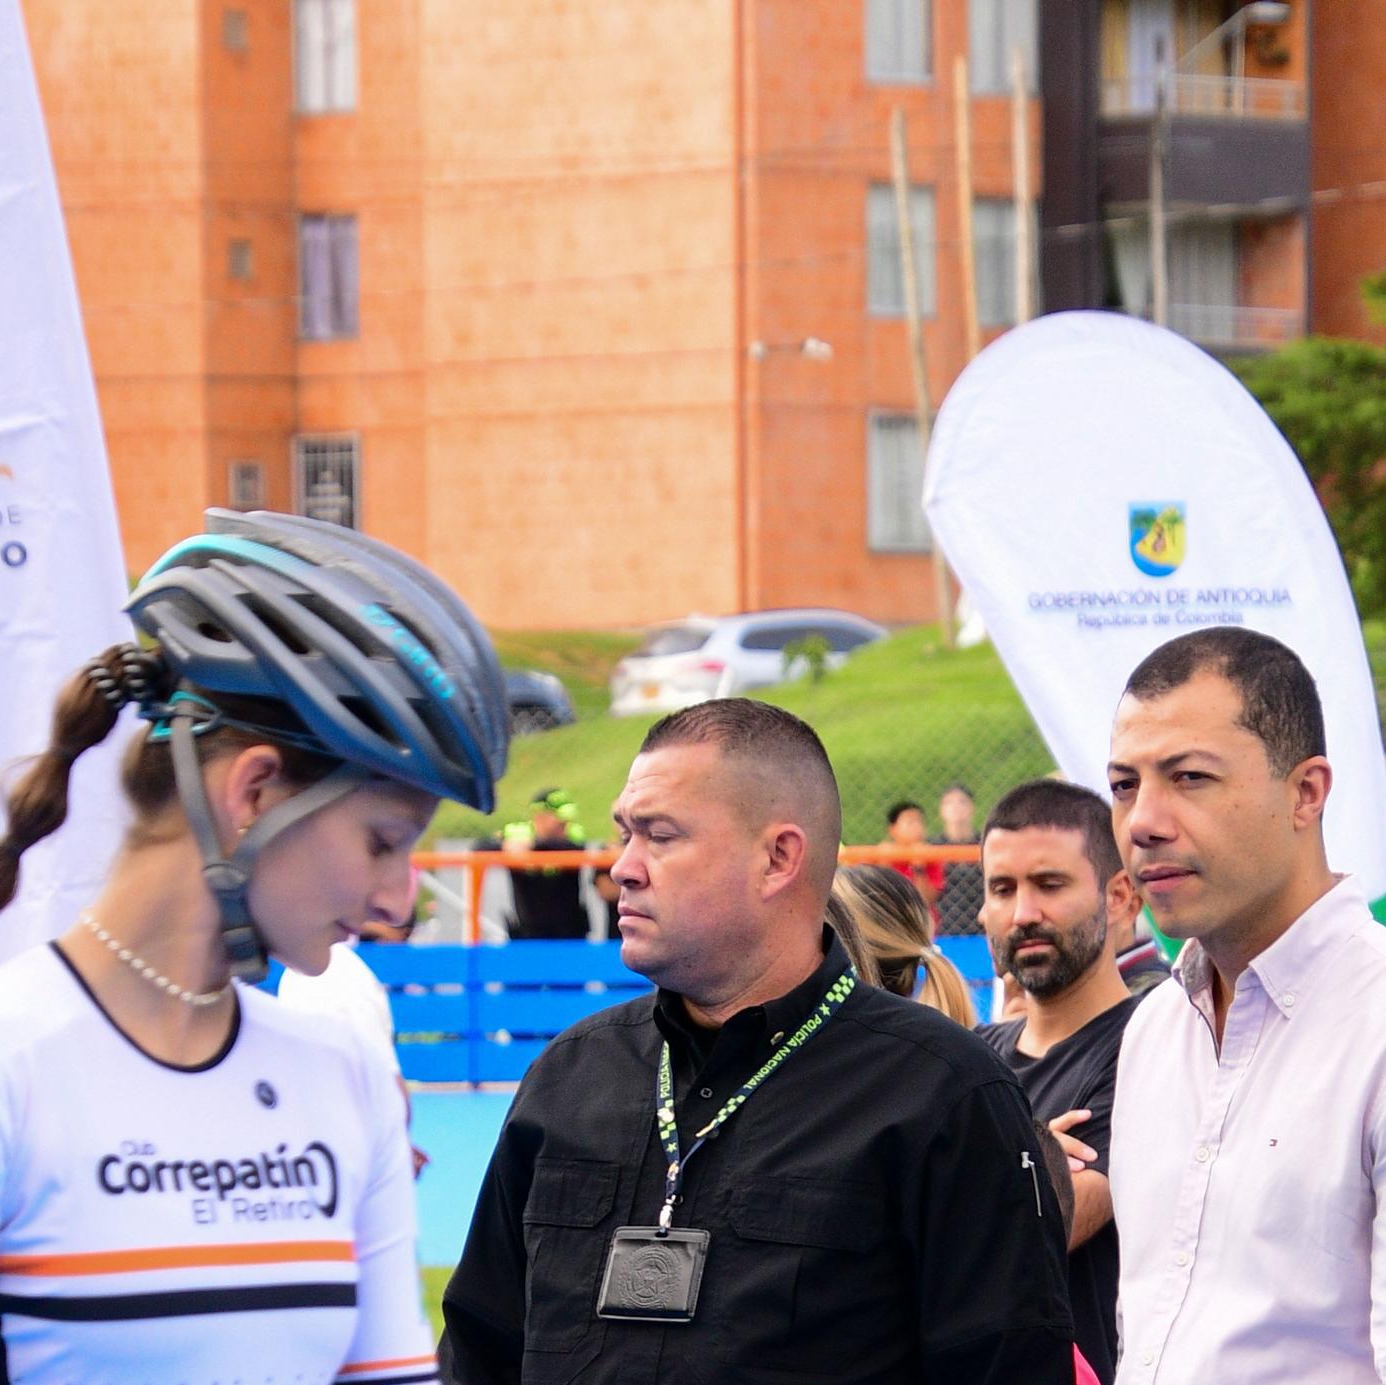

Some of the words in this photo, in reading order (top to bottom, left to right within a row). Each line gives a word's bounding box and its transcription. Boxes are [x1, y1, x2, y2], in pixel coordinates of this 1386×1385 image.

[1028, 588, 1161, 610] GOBERNACIÓN
[1166, 588, 1189, 606] DE
[1196, 588, 1292, 607] ANTIOQUIA
[1077, 611, 1147, 629] República
[1154, 611, 1170, 625] de
[1176, 610, 1244, 625] Colombia
[786, 1013, 823, 1048] POLICÍA
[743, 1045, 792, 1090] NACIONAL
[98, 1142, 321, 1201] Correpatín
[193, 1199, 217, 1225] El
[233, 1197, 313, 1222] Retiro
